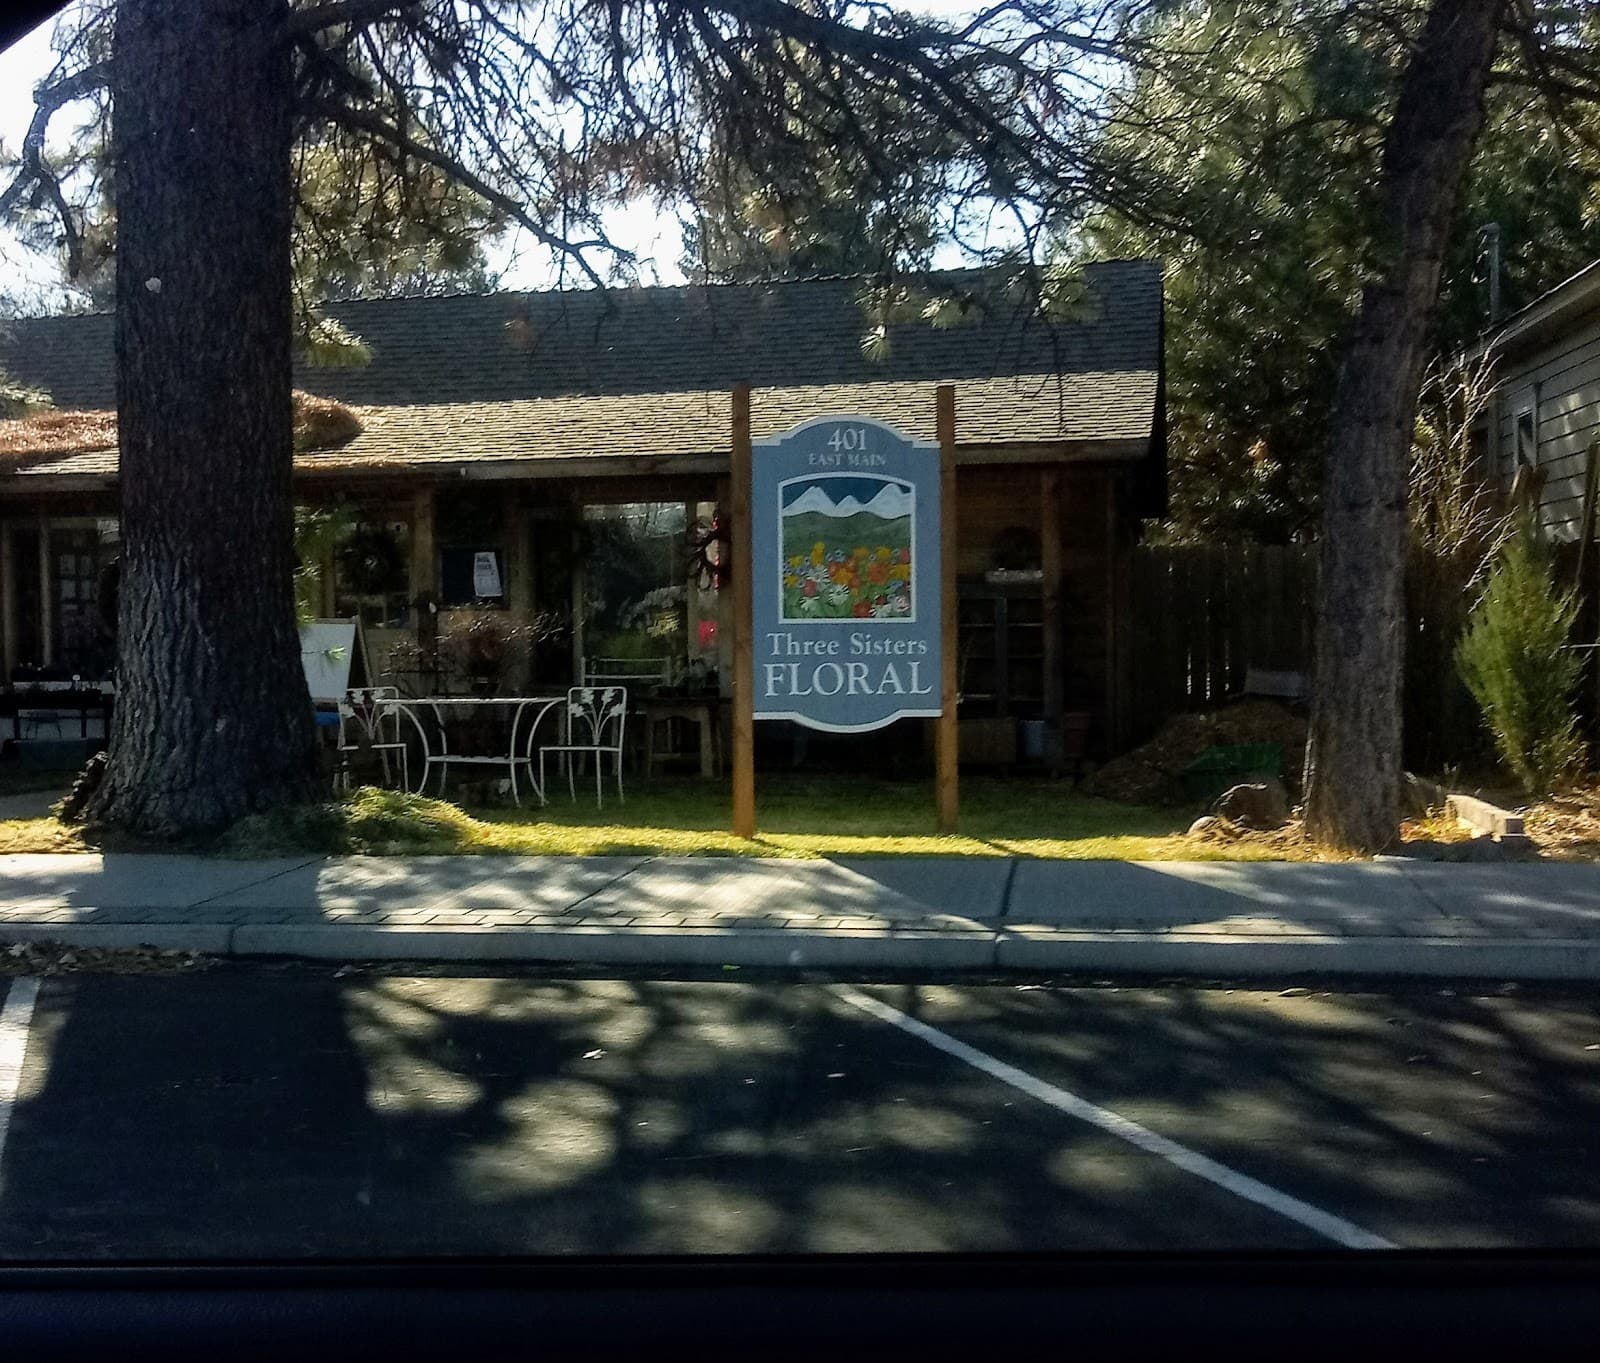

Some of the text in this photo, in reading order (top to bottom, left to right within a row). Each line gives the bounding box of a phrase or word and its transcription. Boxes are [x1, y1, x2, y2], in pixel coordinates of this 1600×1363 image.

[827, 428, 867, 452] 401
[808, 453, 887, 467] EAST MAIN
[767, 632, 928, 656] Three Sisters
[763, 661, 933, 697] FLORAL
